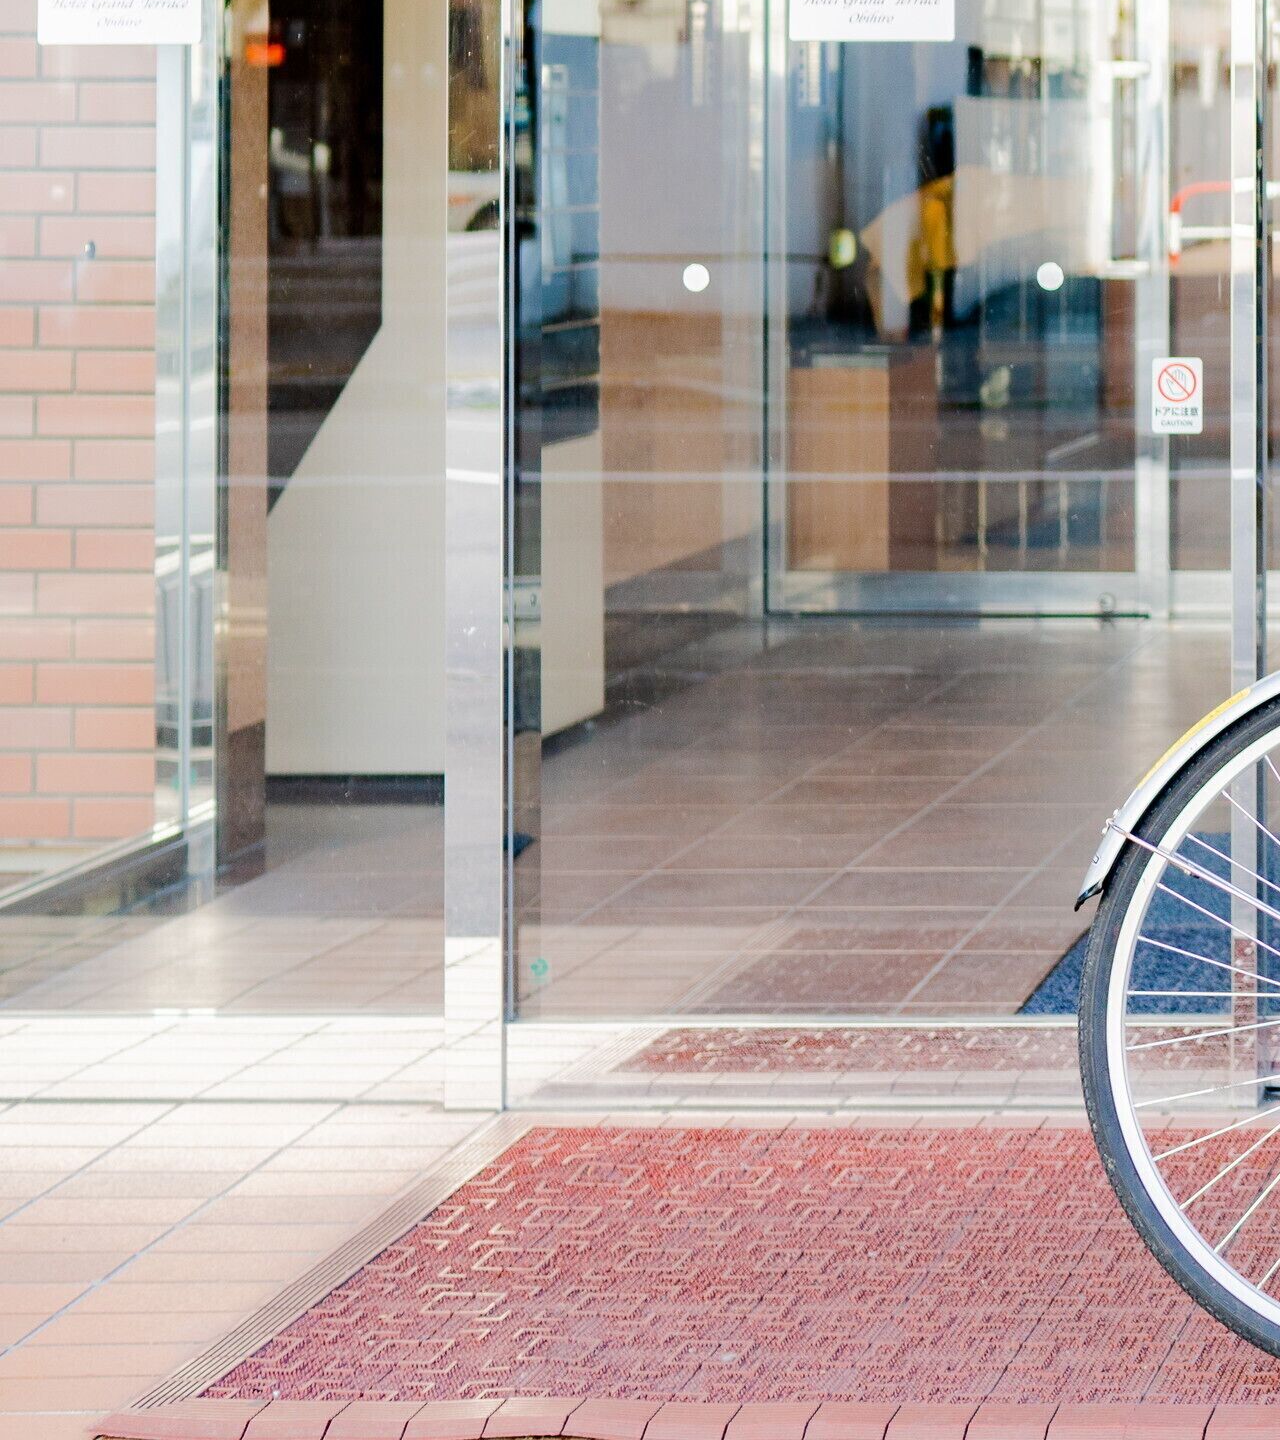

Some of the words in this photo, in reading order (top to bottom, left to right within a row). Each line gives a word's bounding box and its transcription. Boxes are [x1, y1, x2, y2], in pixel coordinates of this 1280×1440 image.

[1155, 406, 1199, 418] ドアに注意
[1161, 419, 1193, 427] CAUTION
